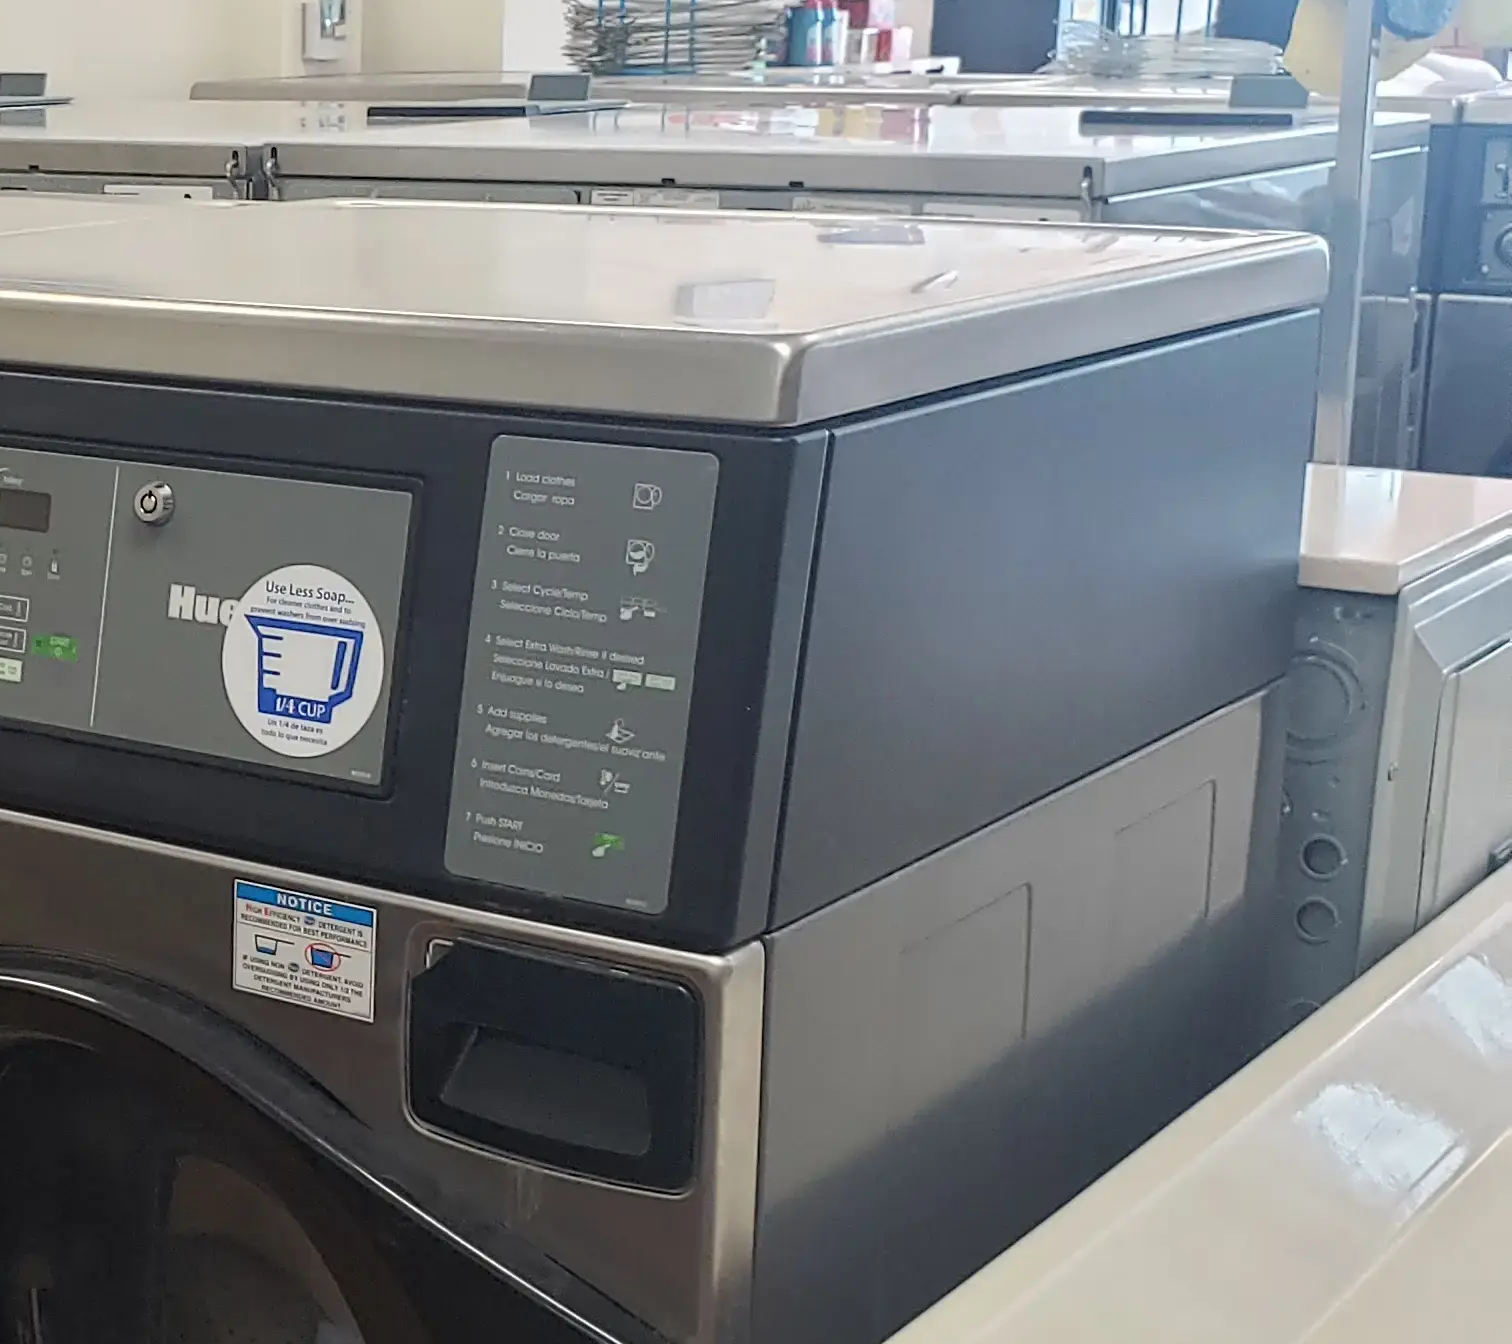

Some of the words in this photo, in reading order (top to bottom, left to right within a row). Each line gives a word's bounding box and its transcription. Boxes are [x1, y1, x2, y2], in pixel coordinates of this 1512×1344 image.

[516, 472, 540, 484] Load
[541, 474, 576, 487] clothes
[513, 490, 548, 504] Cargar
[551, 495, 575, 505] ropa
[498, 525, 504, 535] 2
[509, 527, 535, 539] Close
[537, 530, 560, 541] door
[537, 547, 546, 559] la
[548, 550, 581, 563] puerta
[265, 580, 287, 594] Use
[290, 583, 313, 599] Less
[491, 580, 497, 590] 3
[502, 581, 531, 593] Select
[266, 596, 277, 604] For
[278, 597, 303, 607] cleaner
[304, 602, 328, 611] clothes
[330, 605, 343, 614] and
[250, 606, 275, 615] prevent
[277, 609, 304, 619] washers
[306, 612, 322, 621] from
[323, 615, 338, 624] over
[485, 634, 491, 643] 4
[496, 635, 523, 648] Select
[525, 639, 547, 652] Extra
[609, 652, 645, 666] desired
[493, 653, 543, 670] Seleccione
[545, 661, 580, 675] Lavado
[582, 666, 605, 679] Extra
[544, 679, 552, 689] lo
[276, 697, 295, 714] 1/4
[298, 701, 326, 718] CUP
[488, 706, 508, 719] Add
[509, 710, 548, 725] supplies
[300, 724, 314, 733] taza
[485, 723, 524, 740] Agregar
[525, 730, 539, 742] los
[481, 760, 506, 773] Insert
[475, 813, 497, 827] Push
[499, 818, 523, 831] START
[277, 892, 333, 916] NOTICE
[241, 913, 288, 930] RECOMMENDED
[289, 923, 302, 933] FOR
[303, 927, 320, 937] BEST
[321, 931, 367, 948] PERFORMANCE
[318, 920, 355, 936] DETERGENT
[357, 929, 363, 937] IS
[253, 974, 292, 990] DETERGENT
[271, 960, 285, 970] NON
[344, 979, 364, 989] AVOID
[289, 972, 298, 981] BY
[322, 981, 339, 991] ONLY
[350, 988, 363, 998] THE
